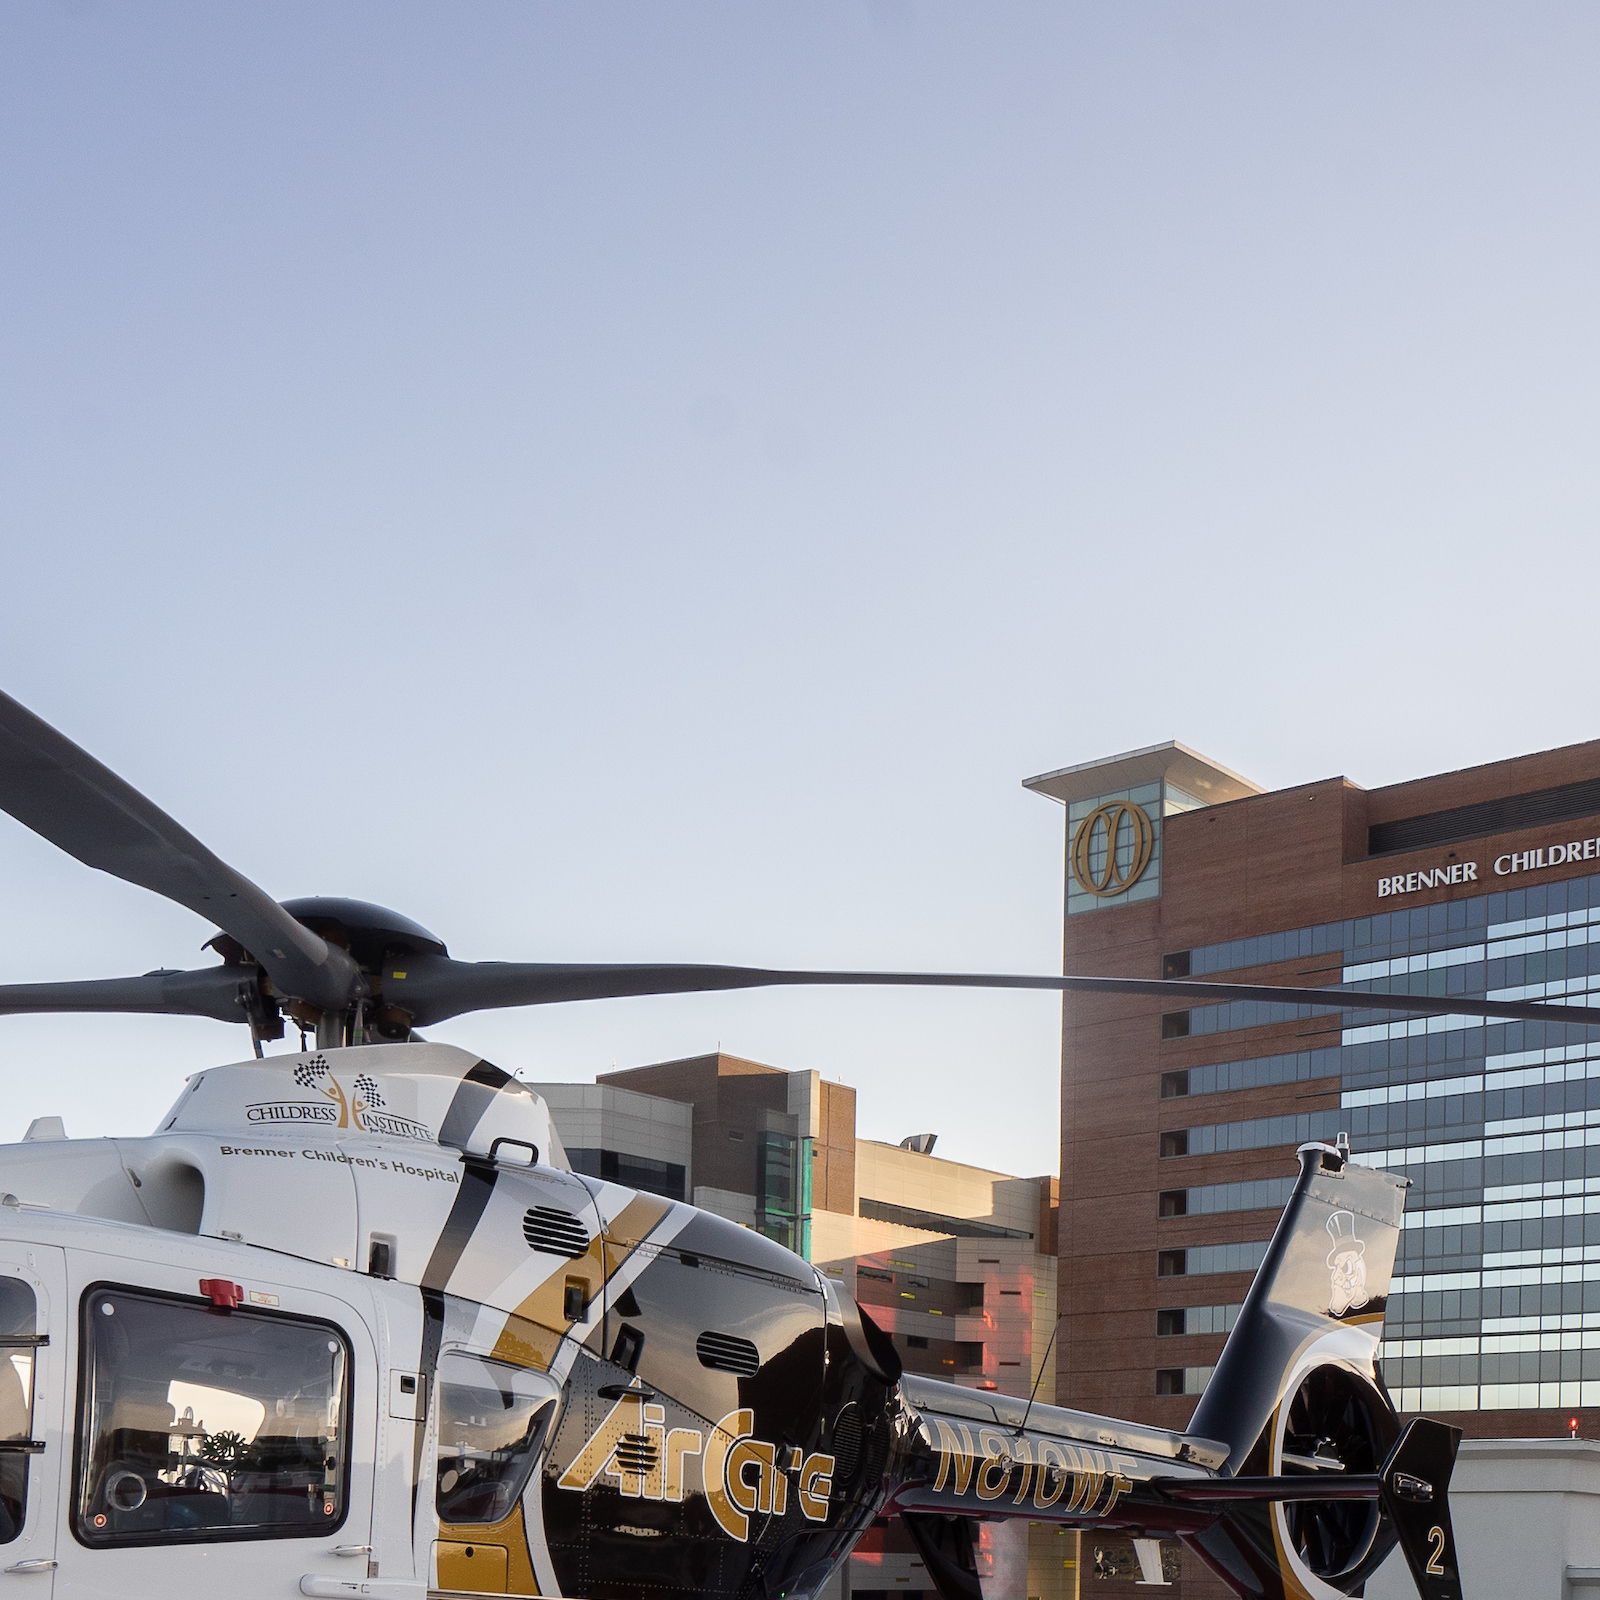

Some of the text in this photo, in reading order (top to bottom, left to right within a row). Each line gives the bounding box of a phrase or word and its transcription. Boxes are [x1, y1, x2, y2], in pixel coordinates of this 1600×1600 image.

[1377, 862, 1477, 897] BRENNER
[247, 1106, 337, 1121] CHILDRESS
[362, 1113, 434, 1140] INSTITUTE
[220, 1145, 460, 1184] Brenner Children's Hospital
[932, 1418, 1138, 1517] N810WF
[1426, 1525, 1445, 1575] 2
